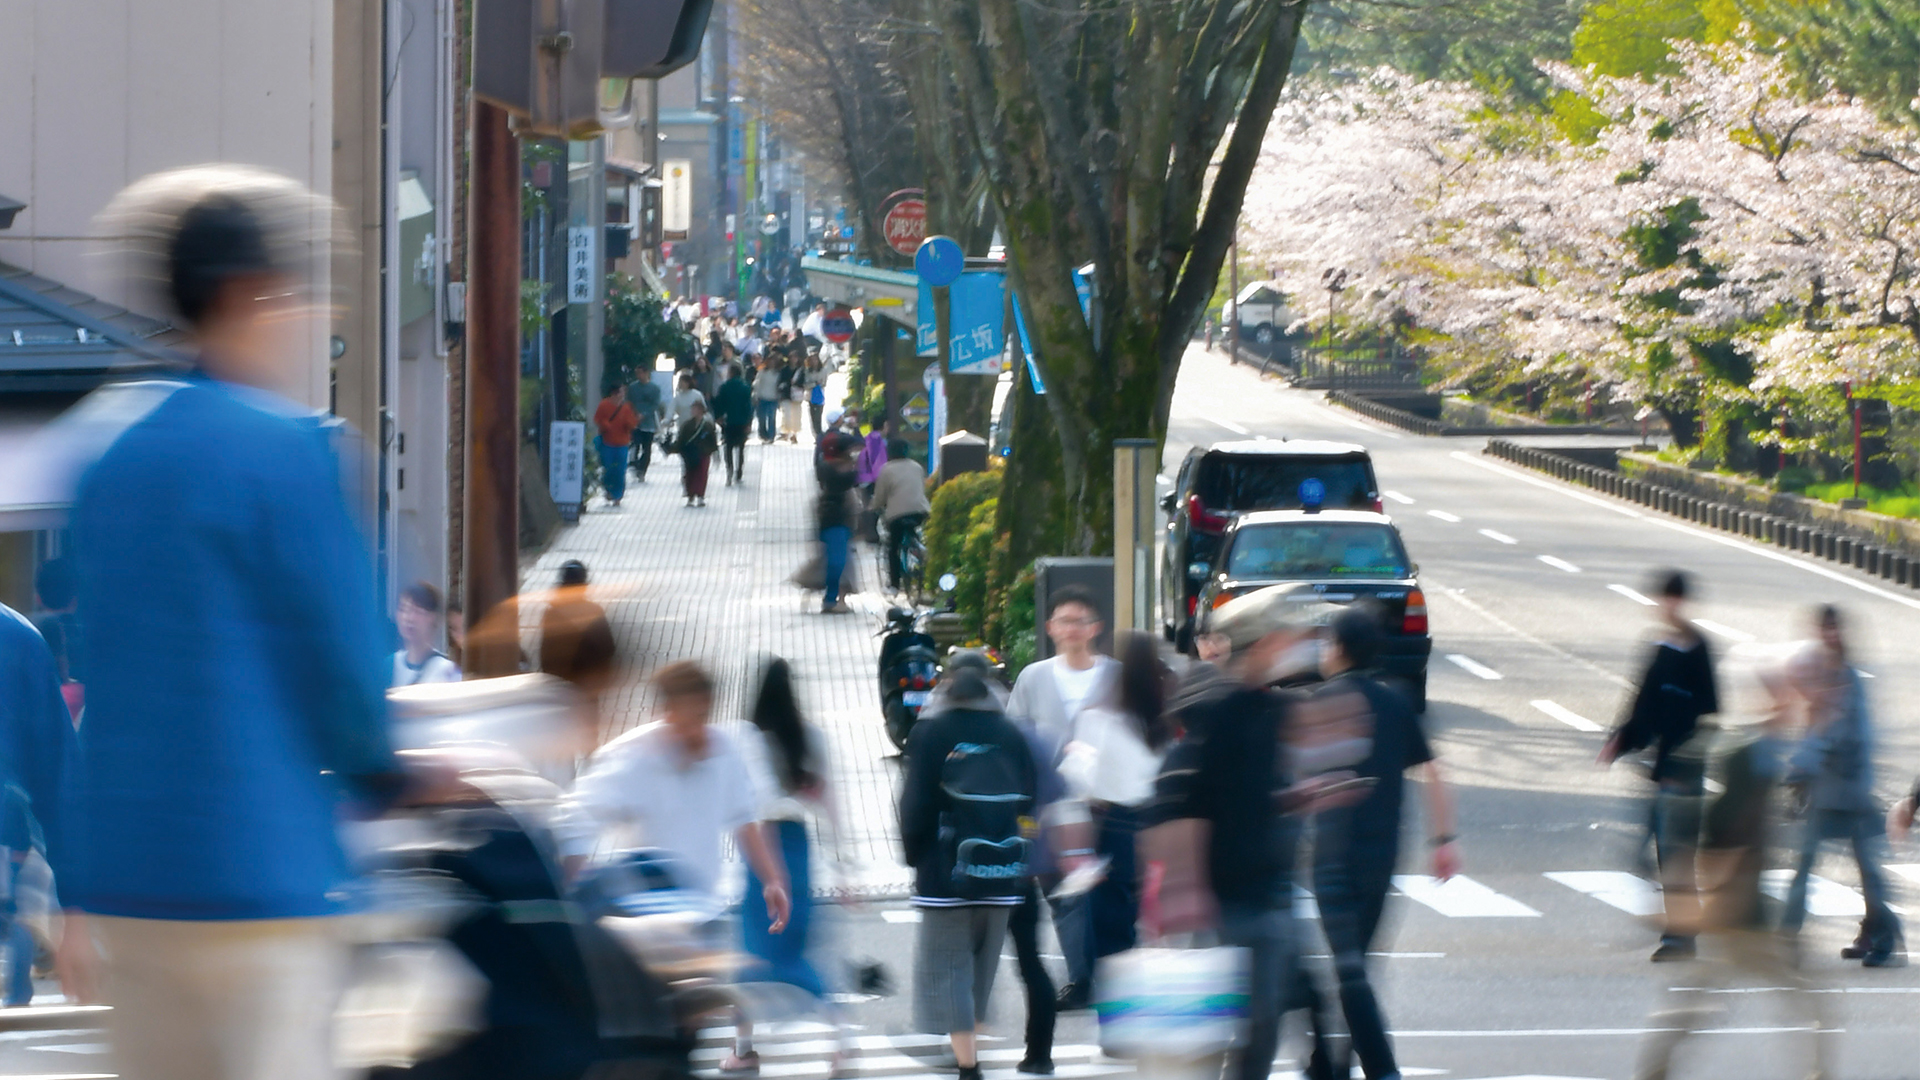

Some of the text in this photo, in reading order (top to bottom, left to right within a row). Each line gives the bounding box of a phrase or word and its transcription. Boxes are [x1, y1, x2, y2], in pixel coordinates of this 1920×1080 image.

[574, 233, 589, 299] 白井美術
[916, 322, 938, 348] 広
[949, 322, 995, 363] 広坂
